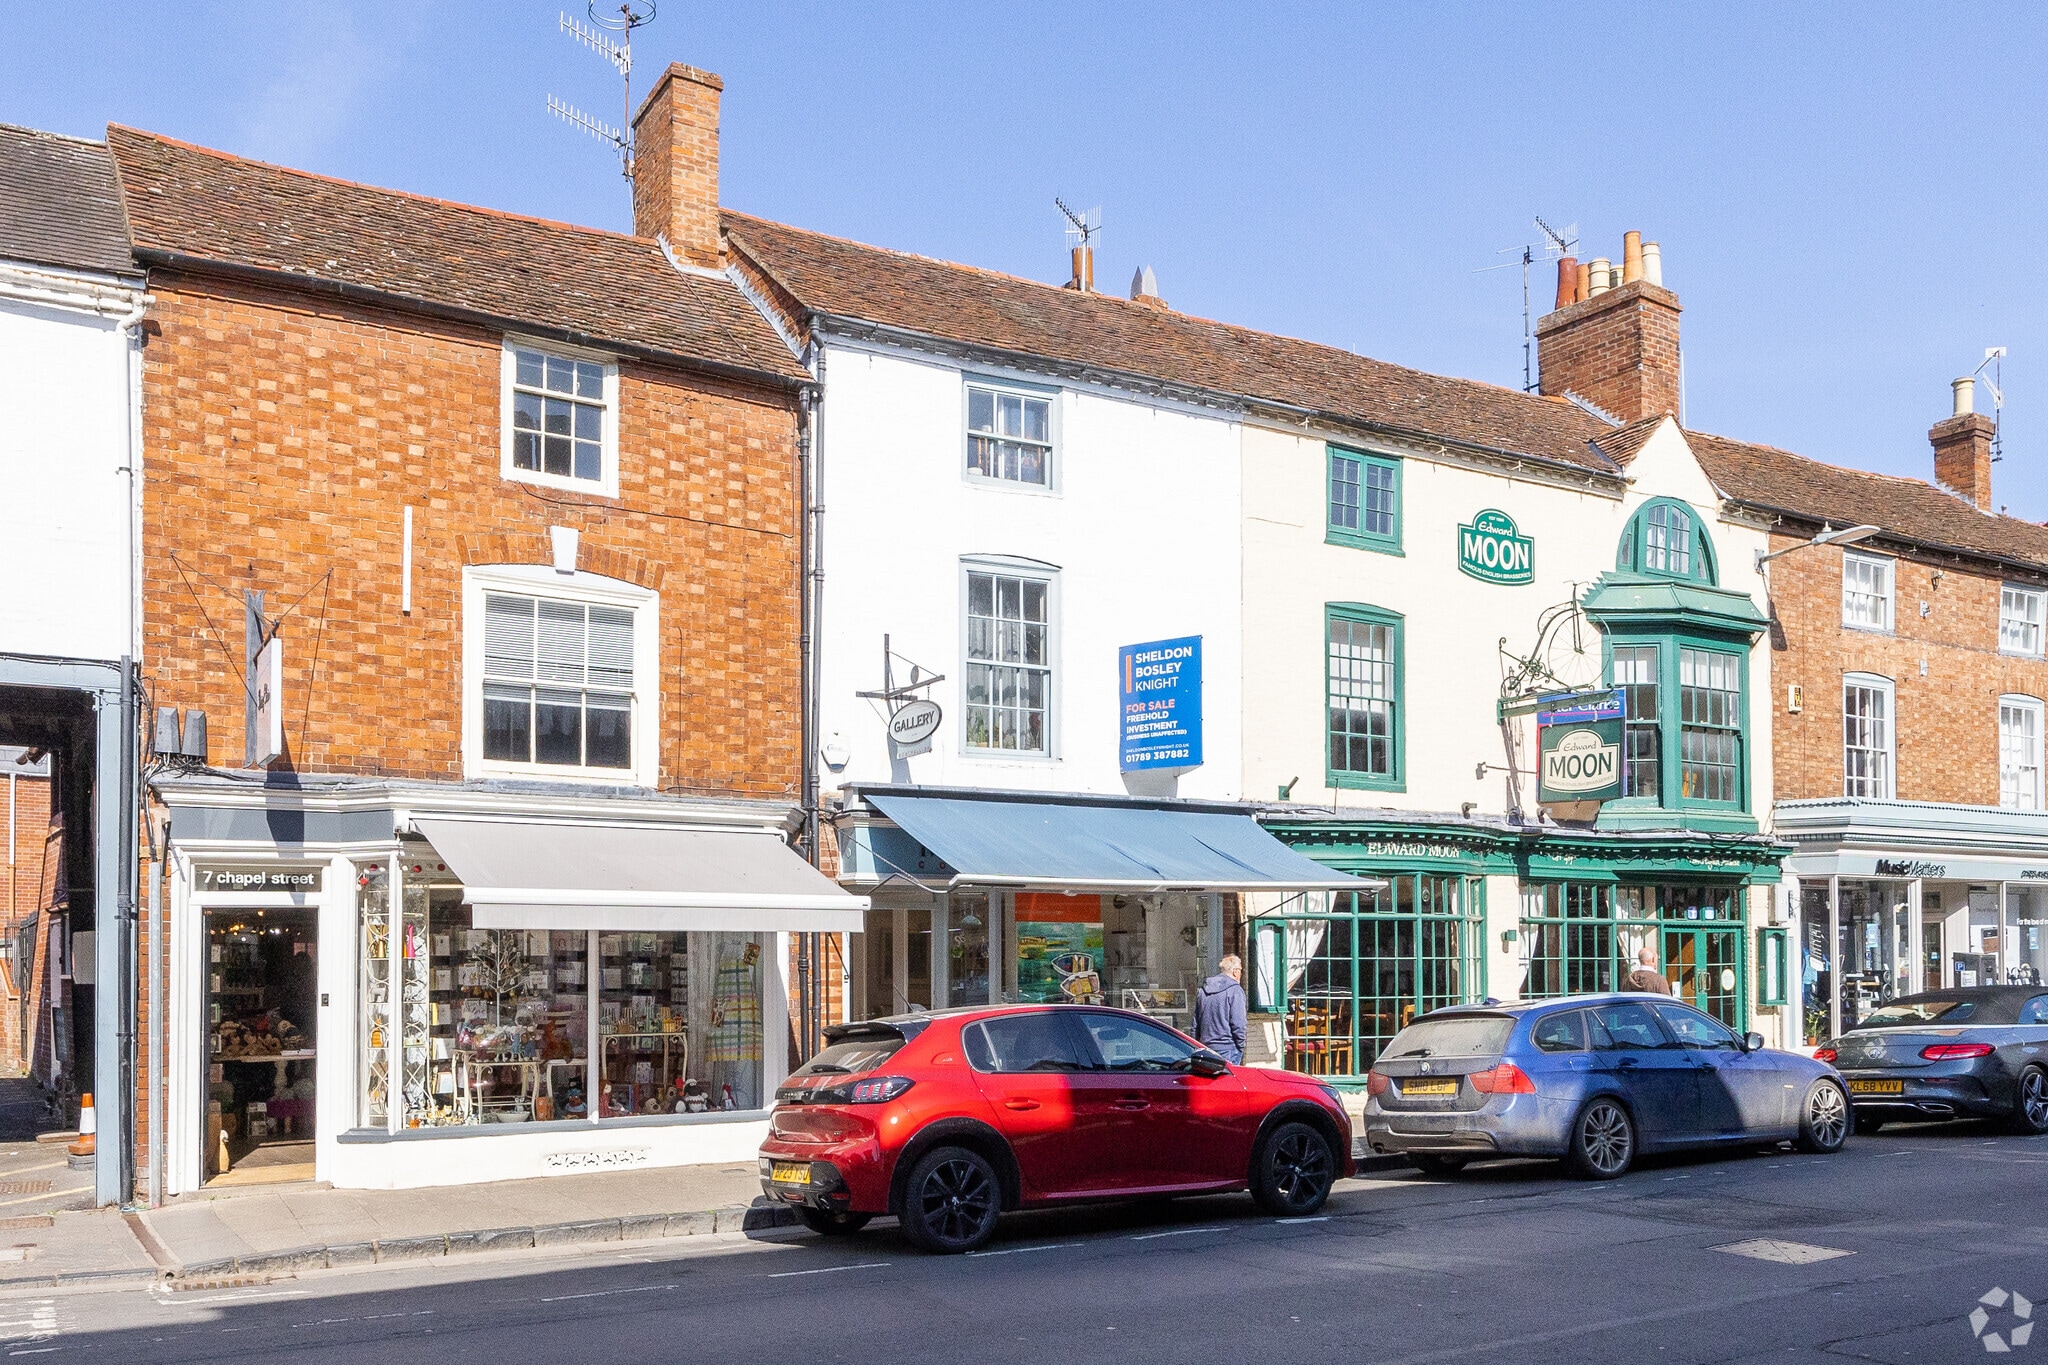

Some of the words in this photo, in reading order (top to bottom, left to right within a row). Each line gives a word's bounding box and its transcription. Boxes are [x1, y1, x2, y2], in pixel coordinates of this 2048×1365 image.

[1478, 521, 1513, 537] Edward
[1463, 532, 1530, 571] MOON
[1135, 646, 1192, 664] SHELDON
[1135, 661, 1182, 678] BOSLEY
[1135, 676, 1179, 692] KNIGHT
[1126, 702, 1146, 714] FOR
[1148, 699, 1175, 710] SALE
[893, 710, 935, 733] GALLERY
[1126, 711, 1169, 723] FREEHOLD
[1126, 720, 1178, 734] INVESTMENT
[1150, 729, 1188, 739] UNAFFECTED)
[1563, 741, 1597, 752] Edward
[1125, 752, 1151, 763] 01789
[1153, 749, 1189, 760] 387882
[1549, 752, 1612, 779] MOON
[1367, 842, 1426, 857] EDWARD
[1427, 844, 1459, 858] MOON
[202, 870, 213, 884] 7
[216, 871, 266, 886] chapel
[271, 873, 315, 885] street
[1850, 1081, 1876, 1091] KL68
[1879, 1081, 1898, 1091] YVV
